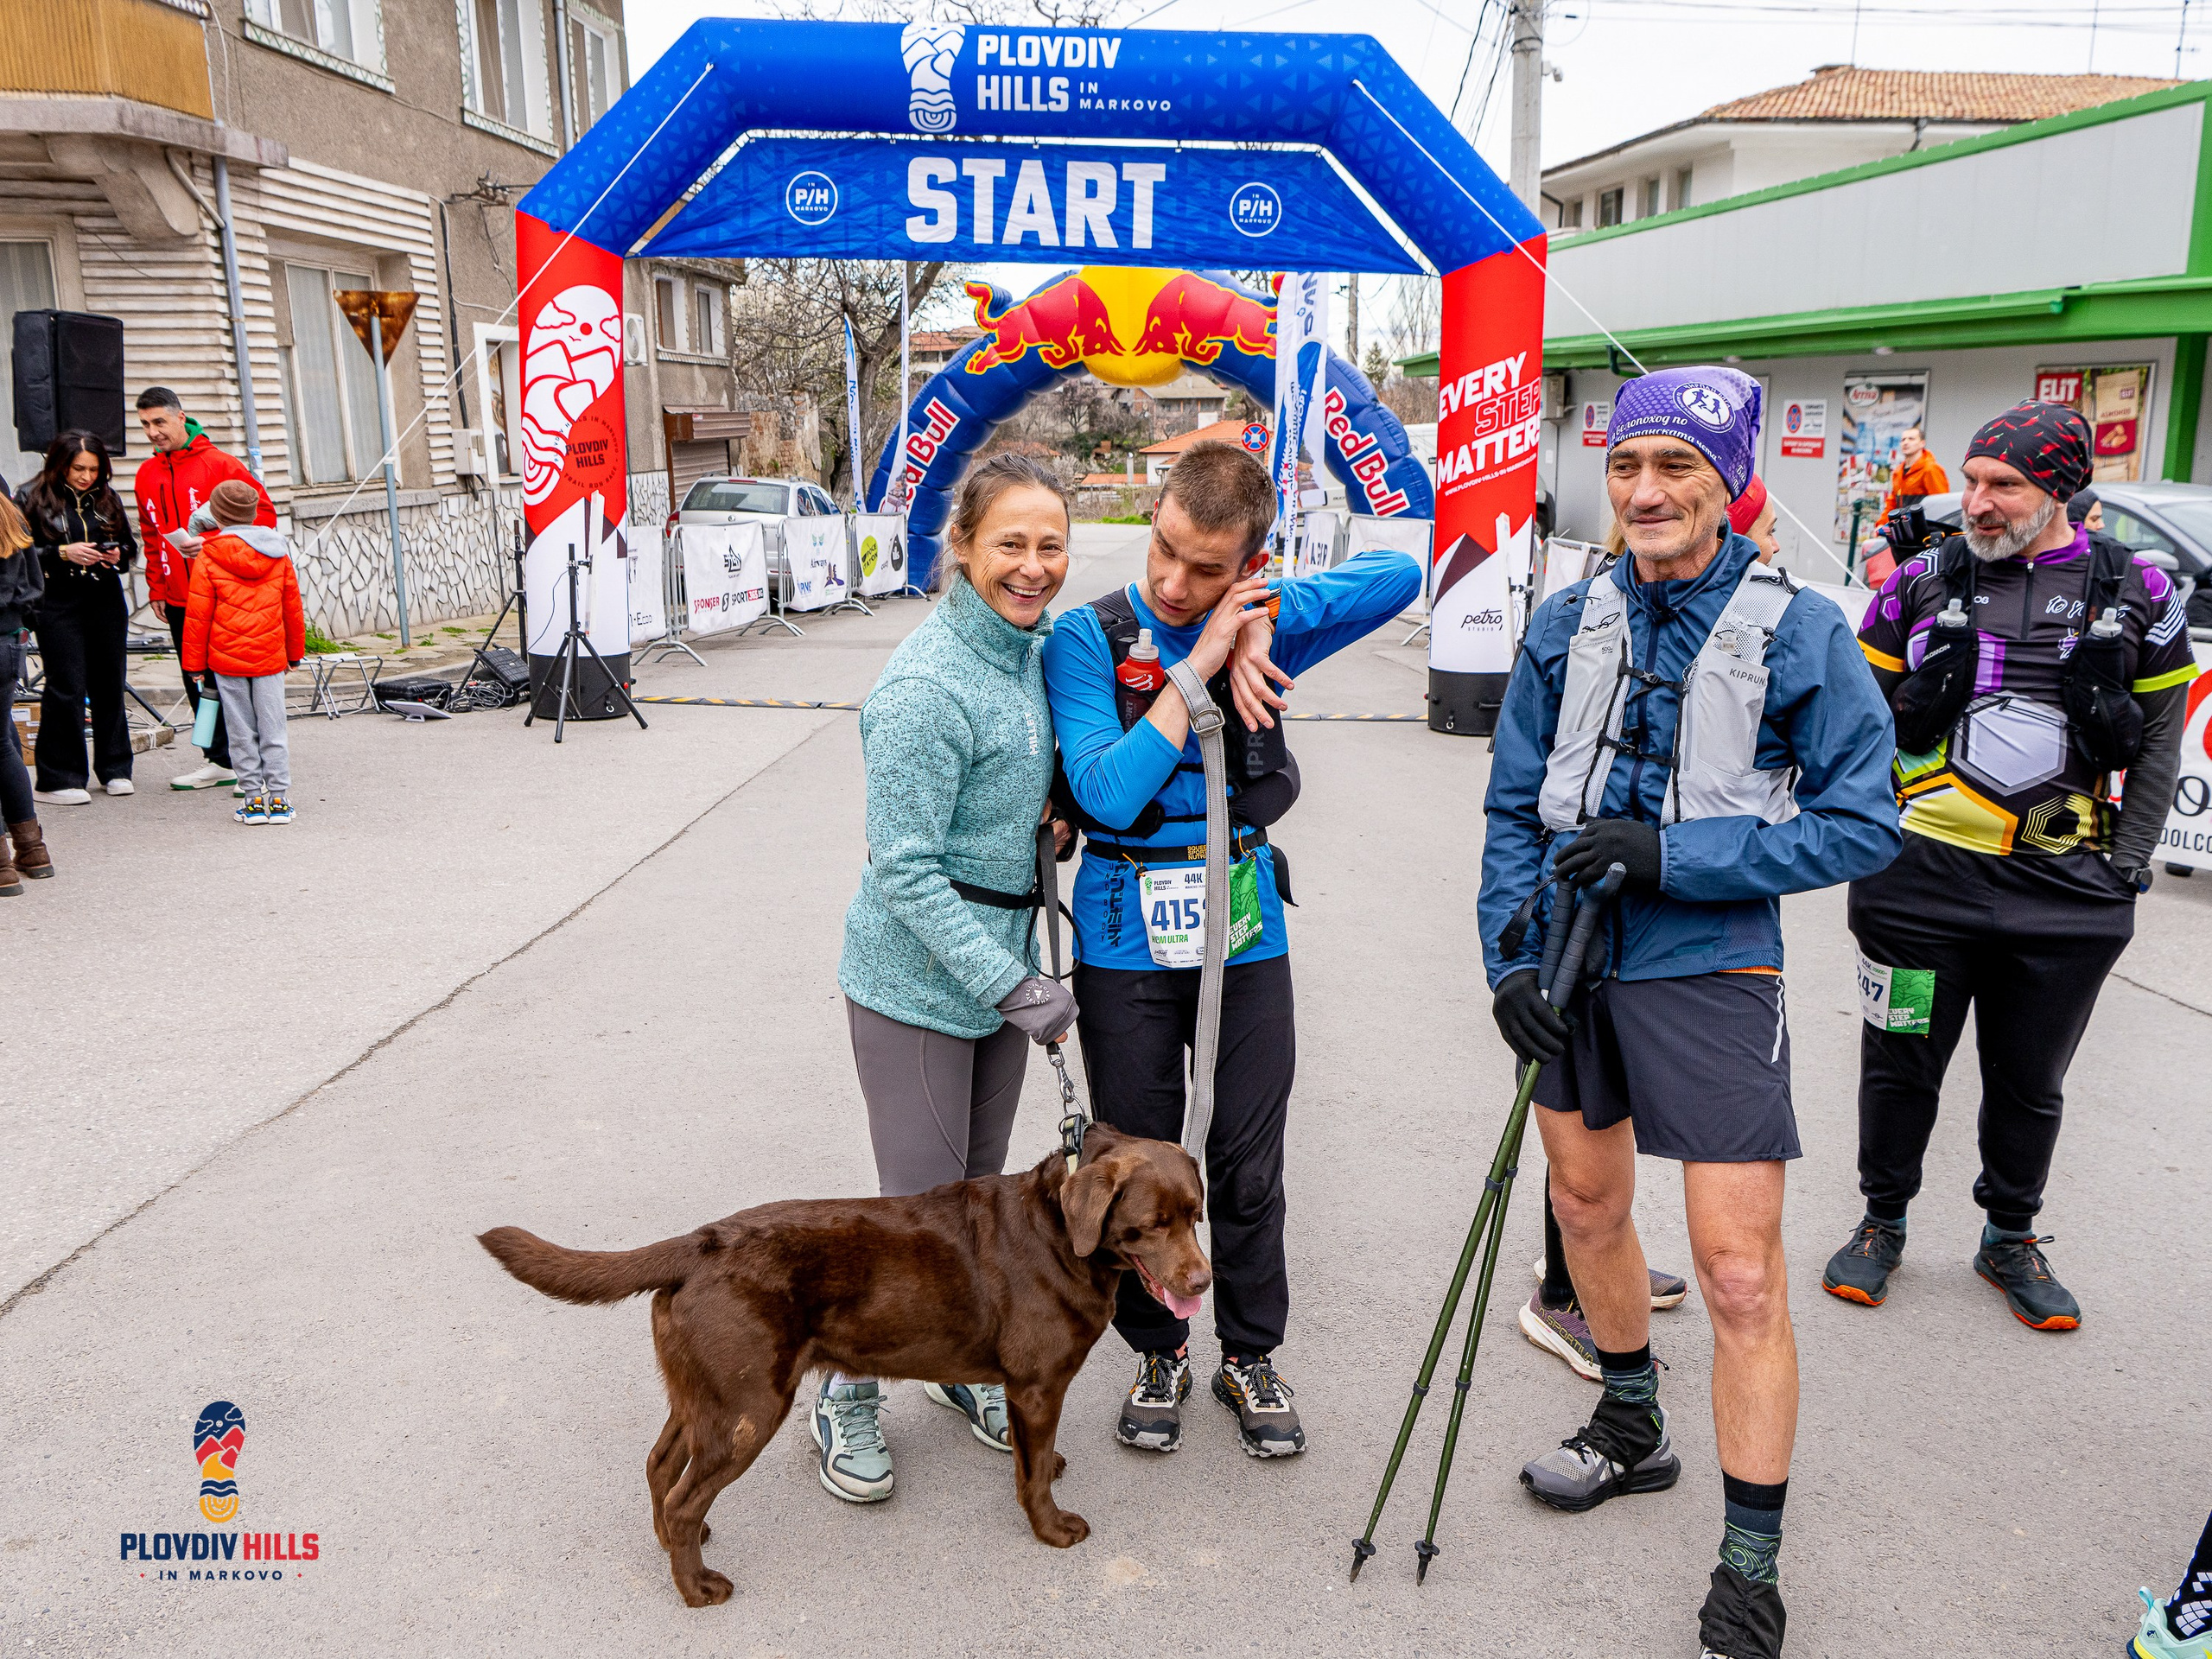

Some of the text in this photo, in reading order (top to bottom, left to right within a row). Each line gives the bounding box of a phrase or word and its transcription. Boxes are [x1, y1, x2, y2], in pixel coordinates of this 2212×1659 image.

[977, 35, 1122, 68] PLOVDIV
[977, 74, 1098, 111] HILLS IN
[1080, 99, 1171, 111] MARKOVO
[795, 188, 829, 206] P/H
[906, 156, 1166, 249] START
[1238, 199, 1273, 218] P/H
[1438, 350, 1527, 423] EVERY
[1474, 377, 1541, 437] STEP
[906, 401, 957, 463] Bull
[1672, 416, 1688, 426] по
[565, 439, 608, 455] PLOVDIV
[1325, 390, 1407, 516] Red Bull
[576, 454, 605, 468] HILLS
[1729, 668, 1766, 686] KIPRUN
[1024, 712, 1039, 755] MILLET
[1184, 873, 1203, 884] 44K
[1151, 898, 1206, 931] 415
[1167, 934, 1189, 944] ULTRA
[1230, 925, 1249, 944] STEP
[1546, 1314, 1594, 1368] SPORTIVA
